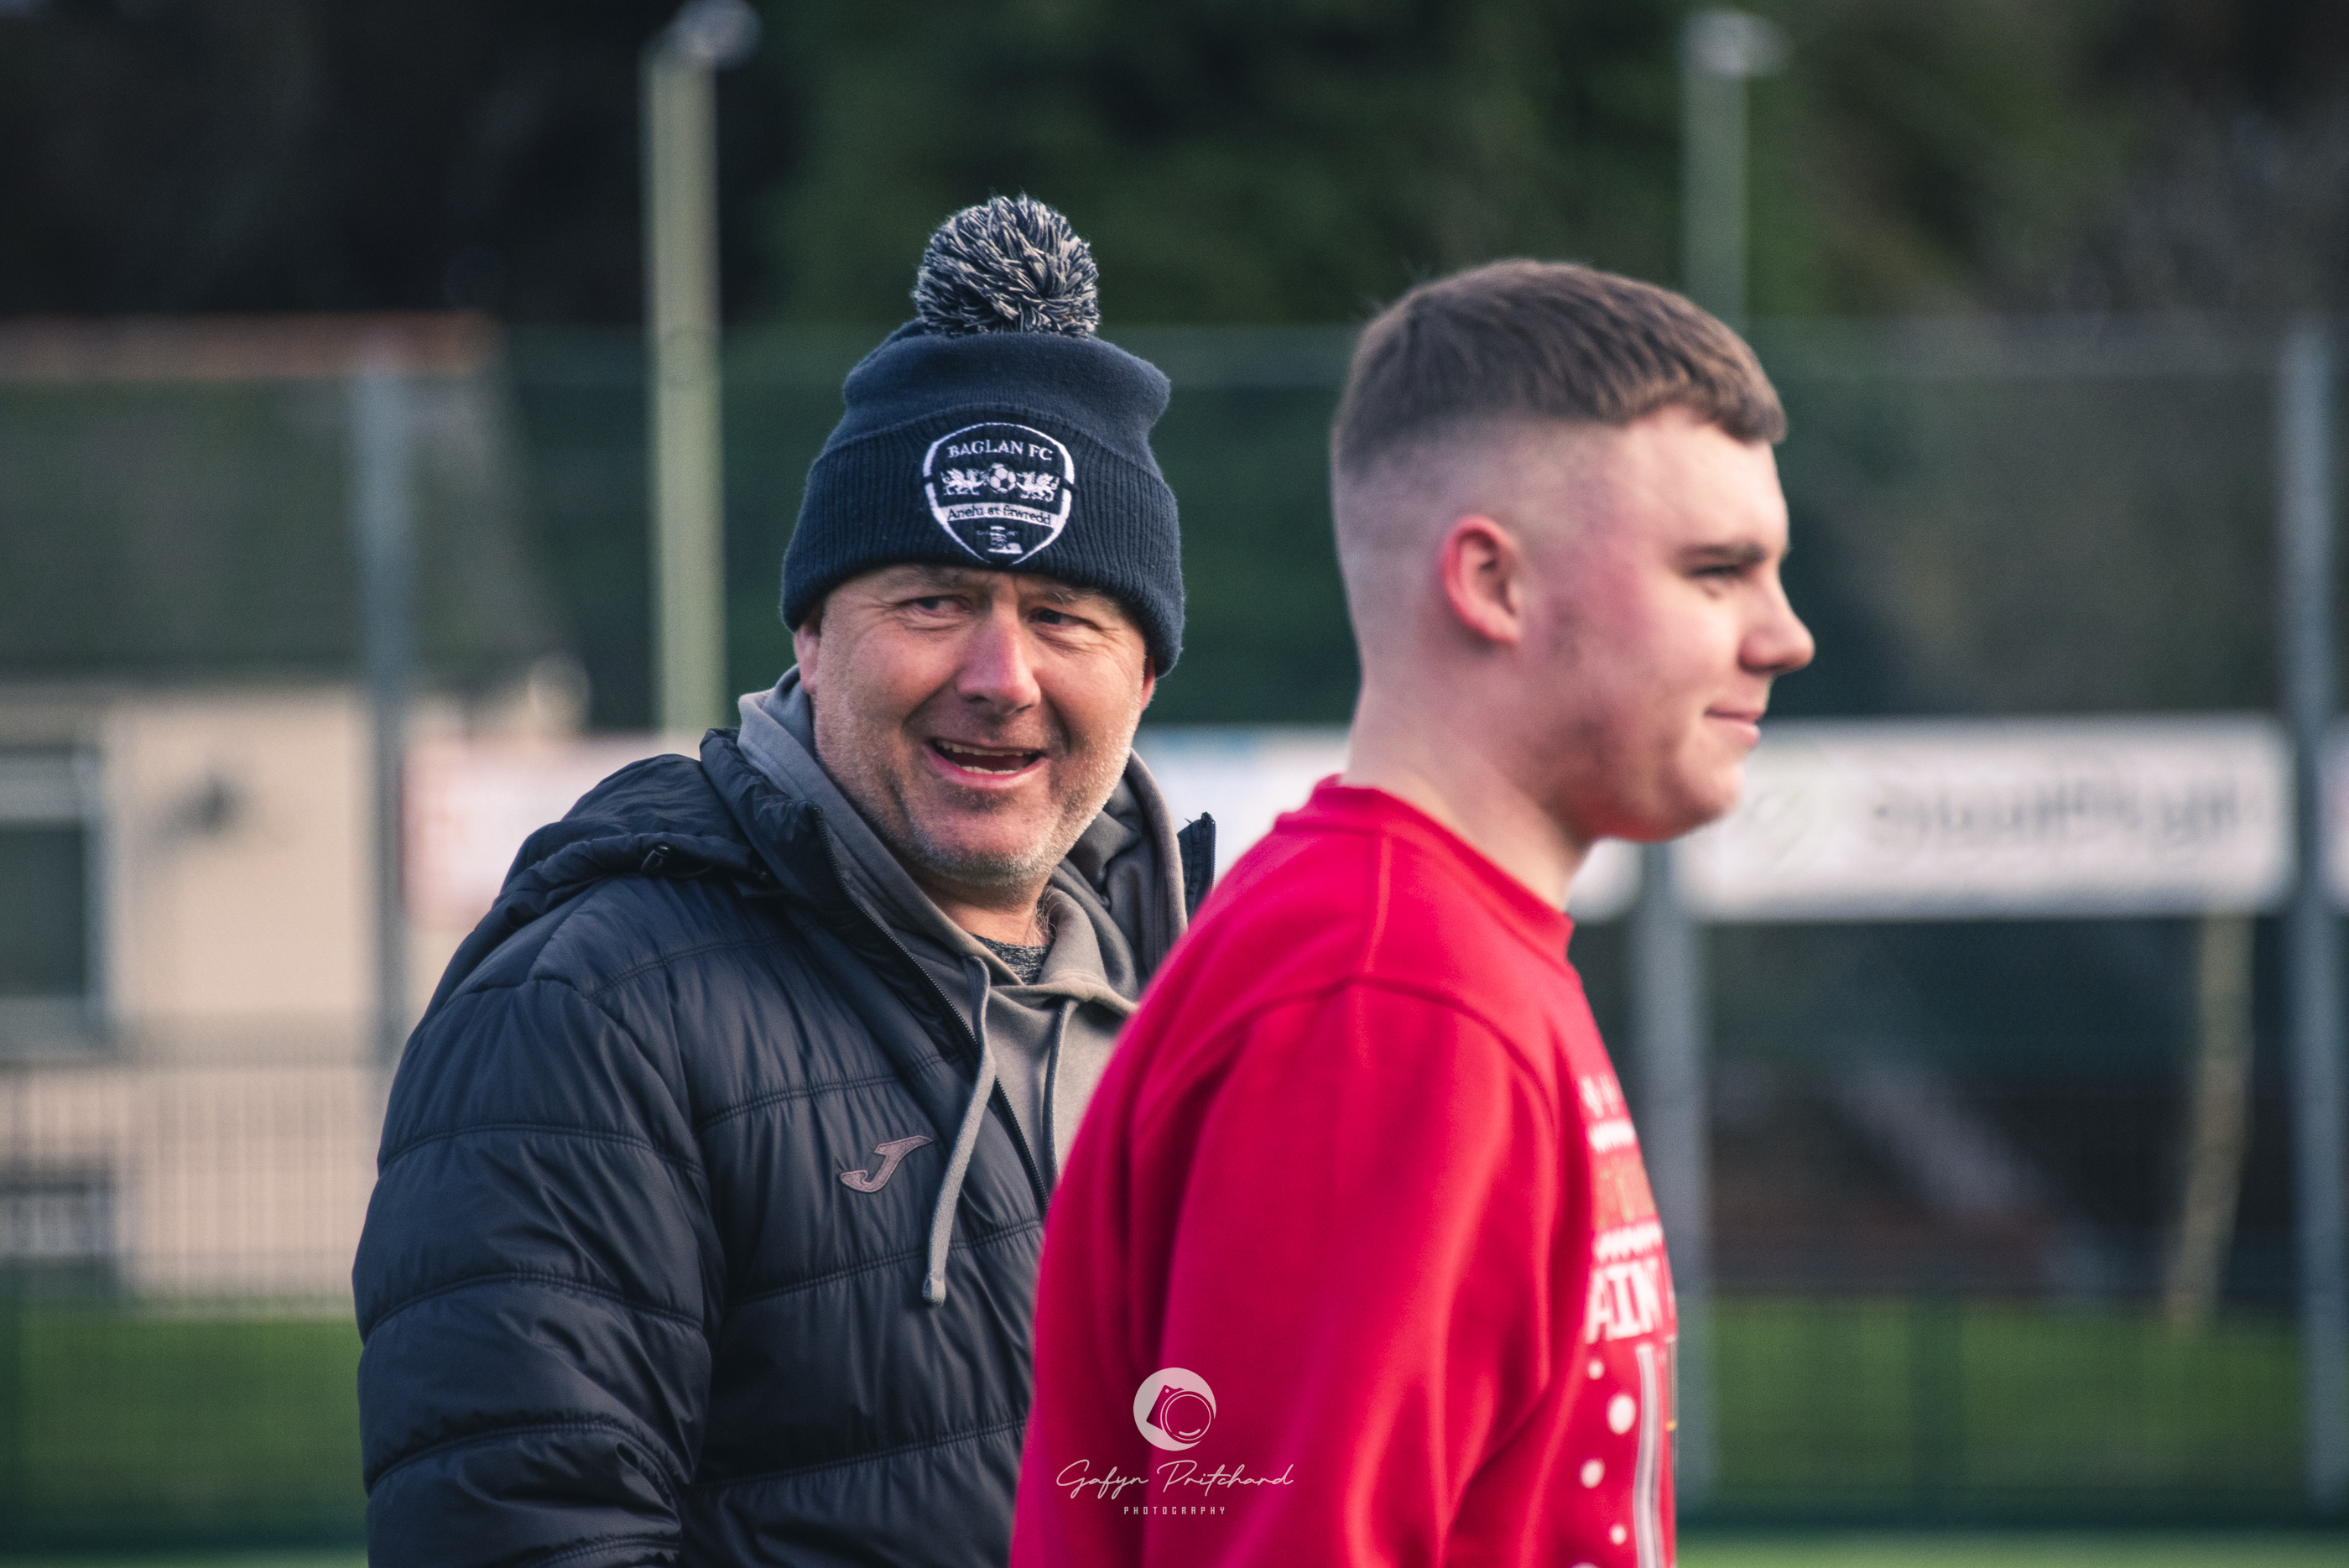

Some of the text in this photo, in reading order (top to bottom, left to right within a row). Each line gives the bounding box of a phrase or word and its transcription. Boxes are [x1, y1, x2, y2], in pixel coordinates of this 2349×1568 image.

[946, 439, 1054, 461] BAGLAN FC
[987, 505, 1000, 516] at
